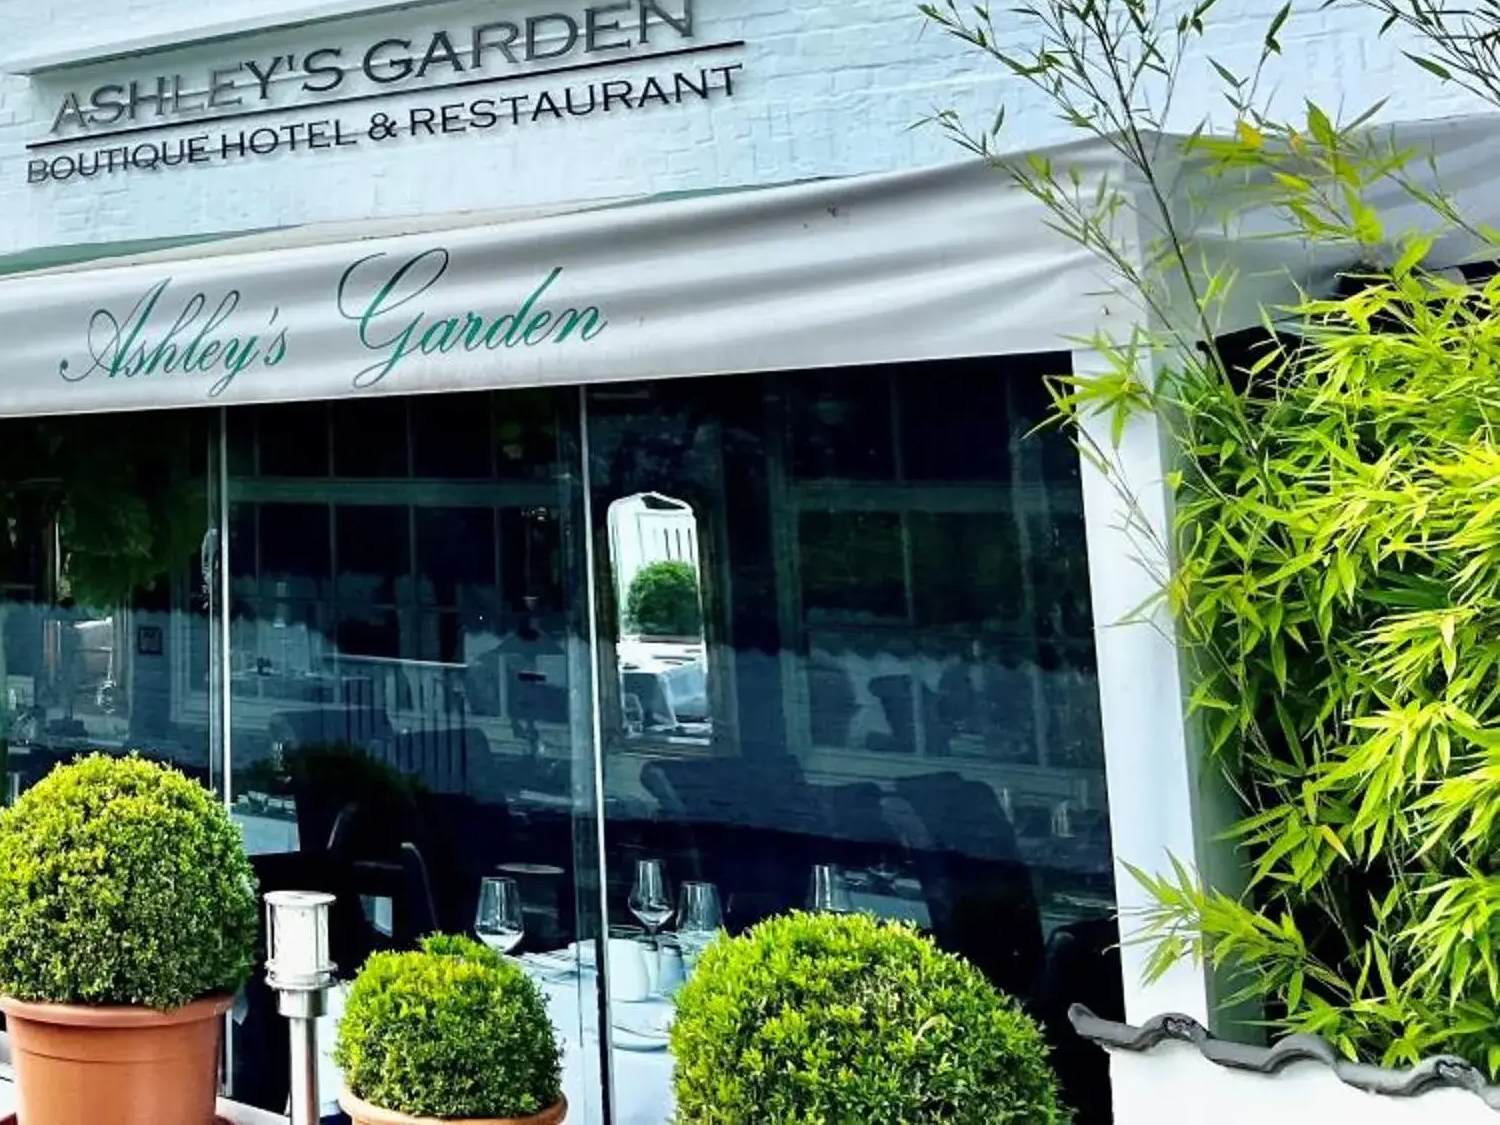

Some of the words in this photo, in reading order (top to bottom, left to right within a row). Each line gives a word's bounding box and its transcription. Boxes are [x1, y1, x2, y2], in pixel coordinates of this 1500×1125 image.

[26, 135, 209, 184] BOUTIQUE
[220, 119, 357, 160] HOTEL
[367, 112, 398, 141] &
[410, 63, 744, 137] RESTAURANT
[50, 48, 345, 132] ASHLEY'S
[59, 277, 290, 396] Ashley's
[336, 247, 608, 389] Garden
